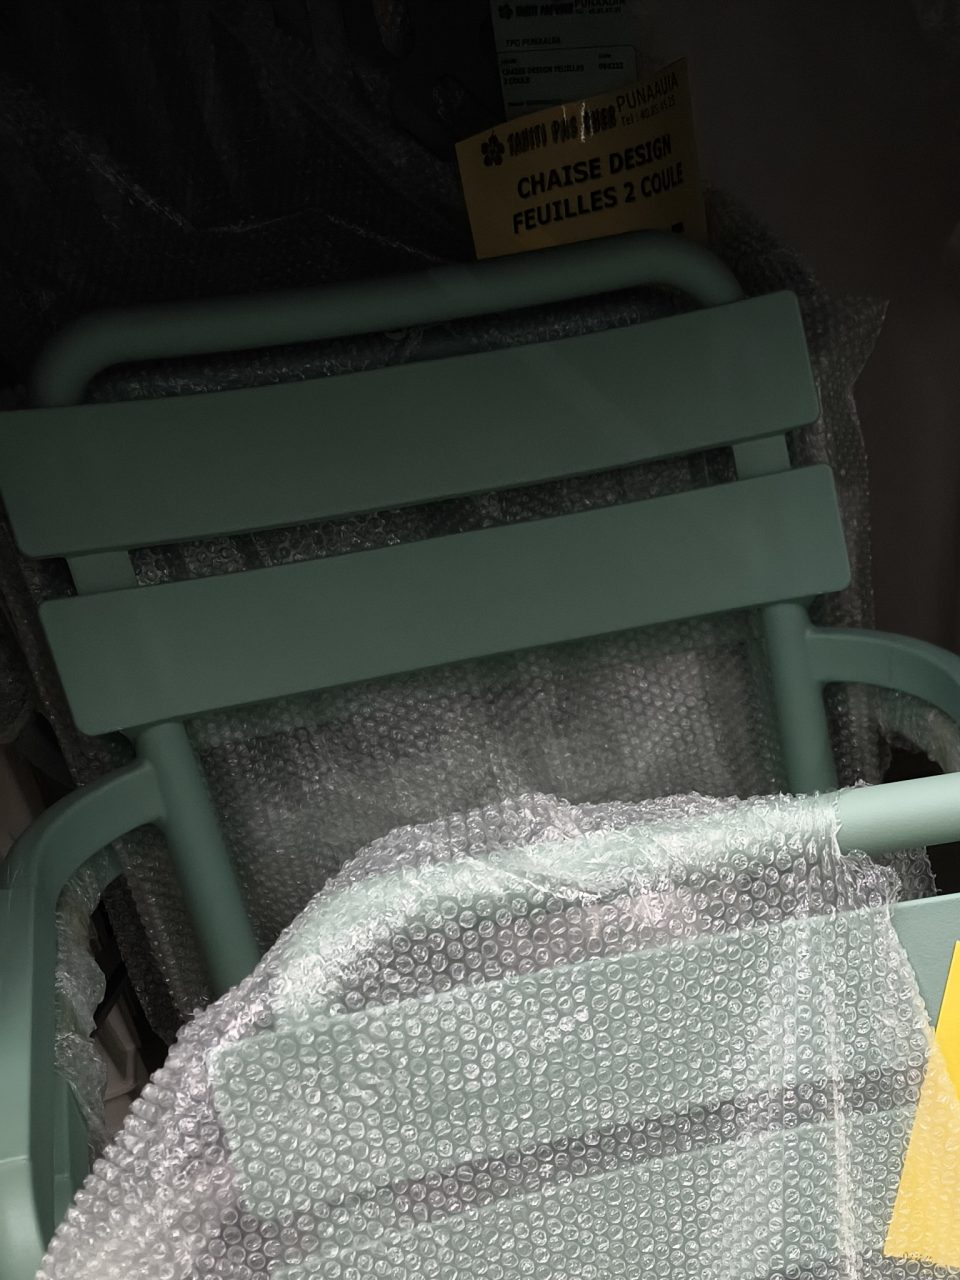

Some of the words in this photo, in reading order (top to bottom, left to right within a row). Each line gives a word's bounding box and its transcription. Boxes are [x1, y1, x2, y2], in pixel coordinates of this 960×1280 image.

[616, 72, 679, 112] PUNAAUIA
[512, 186, 618, 235] FEUILLES
[623, 182, 636, 203] 2
[640, 161, 684, 197] COULE
[518, 157, 602, 200] CHAISE
[609, 133, 672, 174] DESIGN
